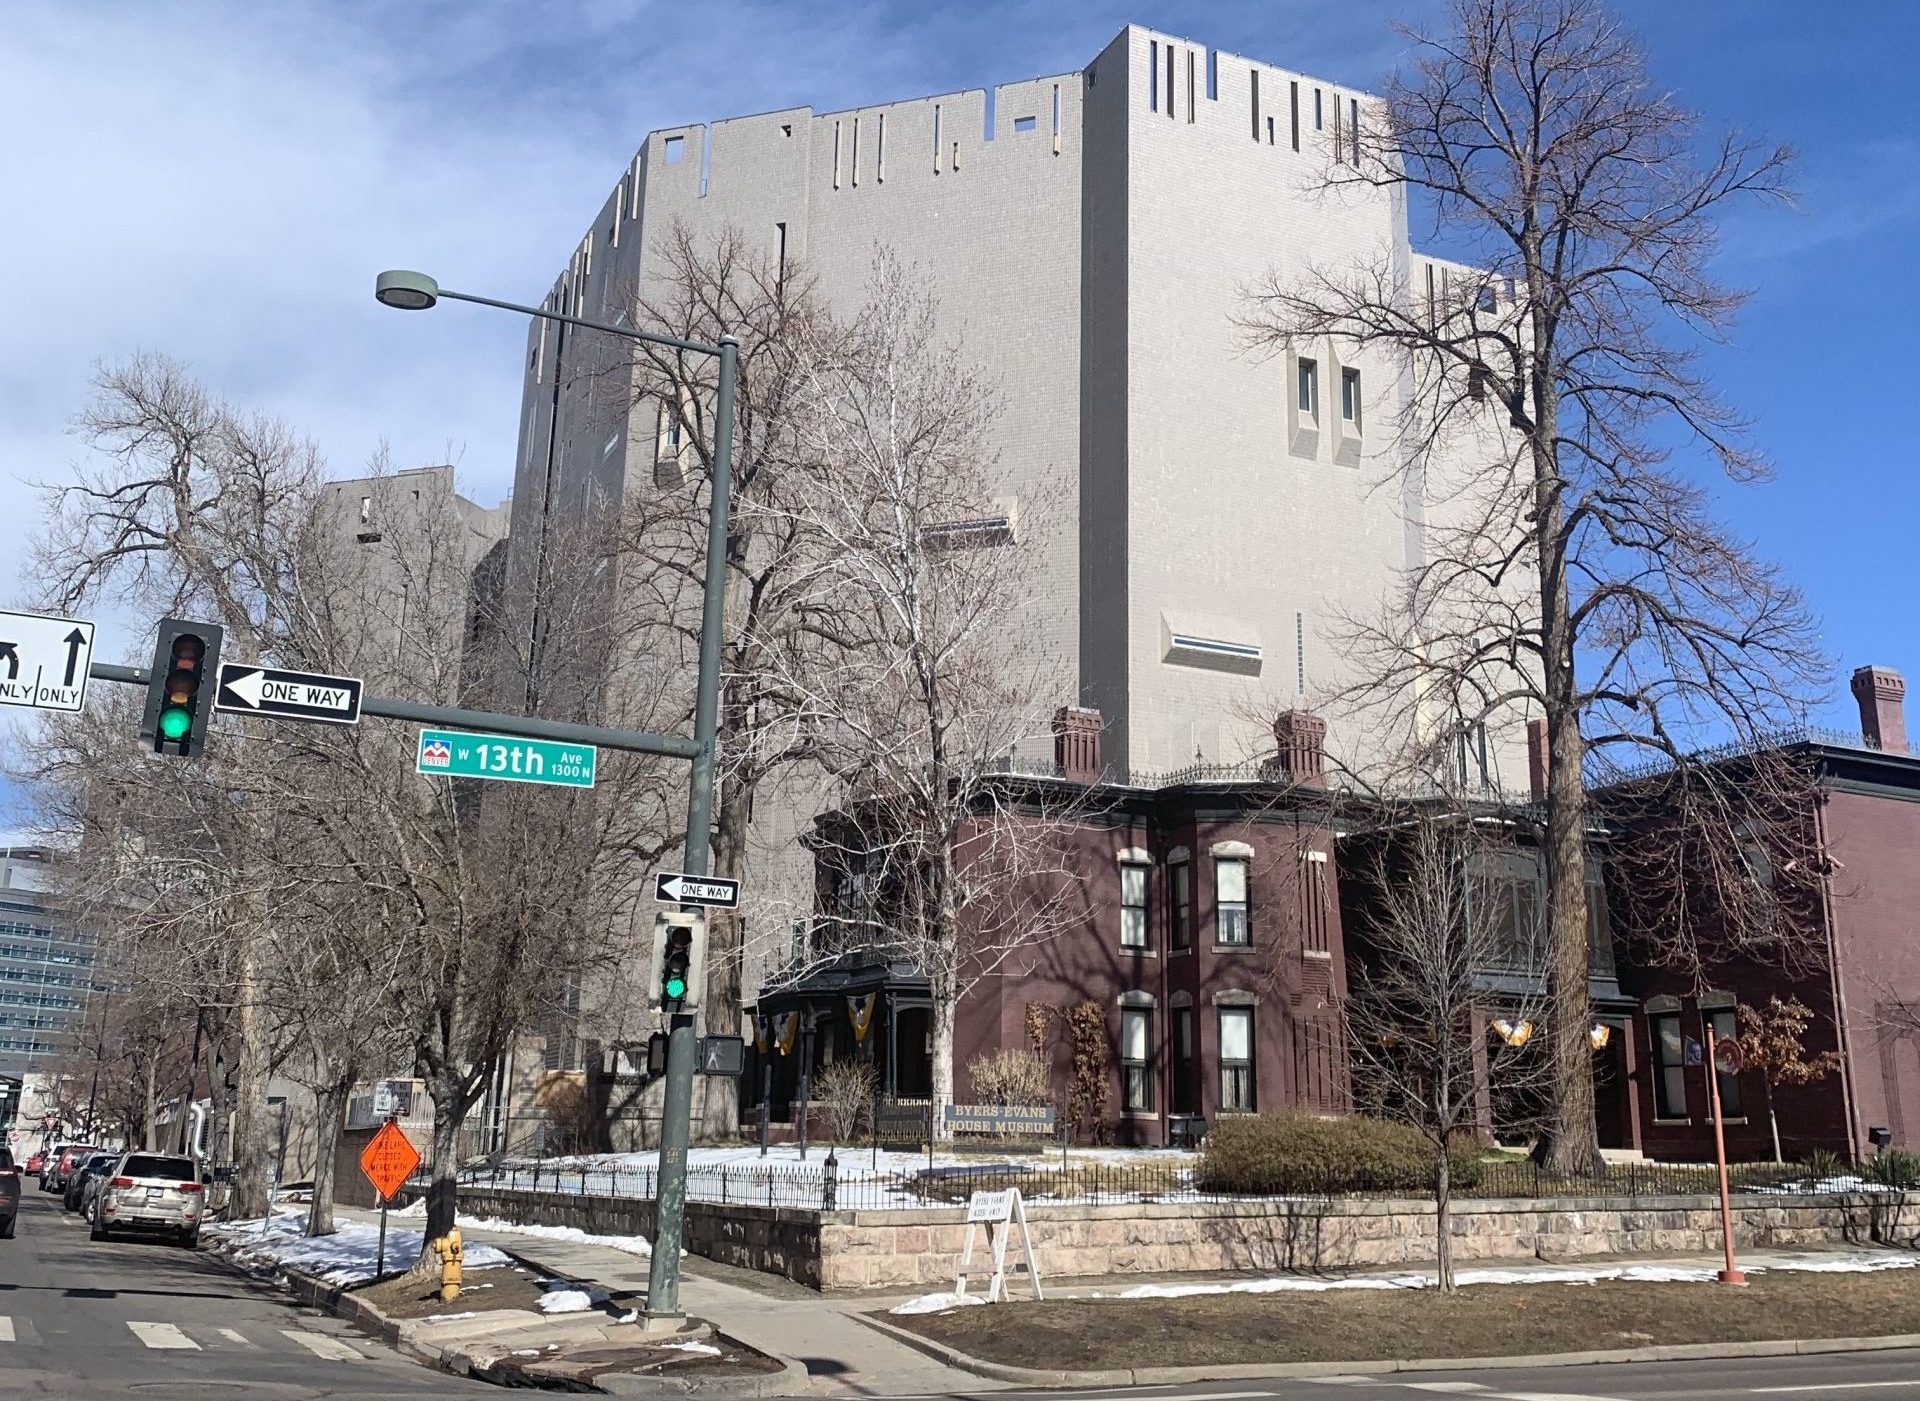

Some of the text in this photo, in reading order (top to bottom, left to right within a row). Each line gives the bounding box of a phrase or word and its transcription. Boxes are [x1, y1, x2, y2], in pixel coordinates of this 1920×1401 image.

[0, 683, 33, 699] NLY
[40, 687, 79, 704] ONLY
[262, 682, 345, 707] ONE WAY
[422, 756, 449, 767] DENVER
[458, 743, 583, 776] W 13th Ave
[551, 763, 590, 779] 1300 N
[681, 883, 729, 898] ONE WAY
[954, 1105, 1047, 1118] BYERS-EVANS
[947, 1120, 1055, 1134] HOUSE MUSEUM
